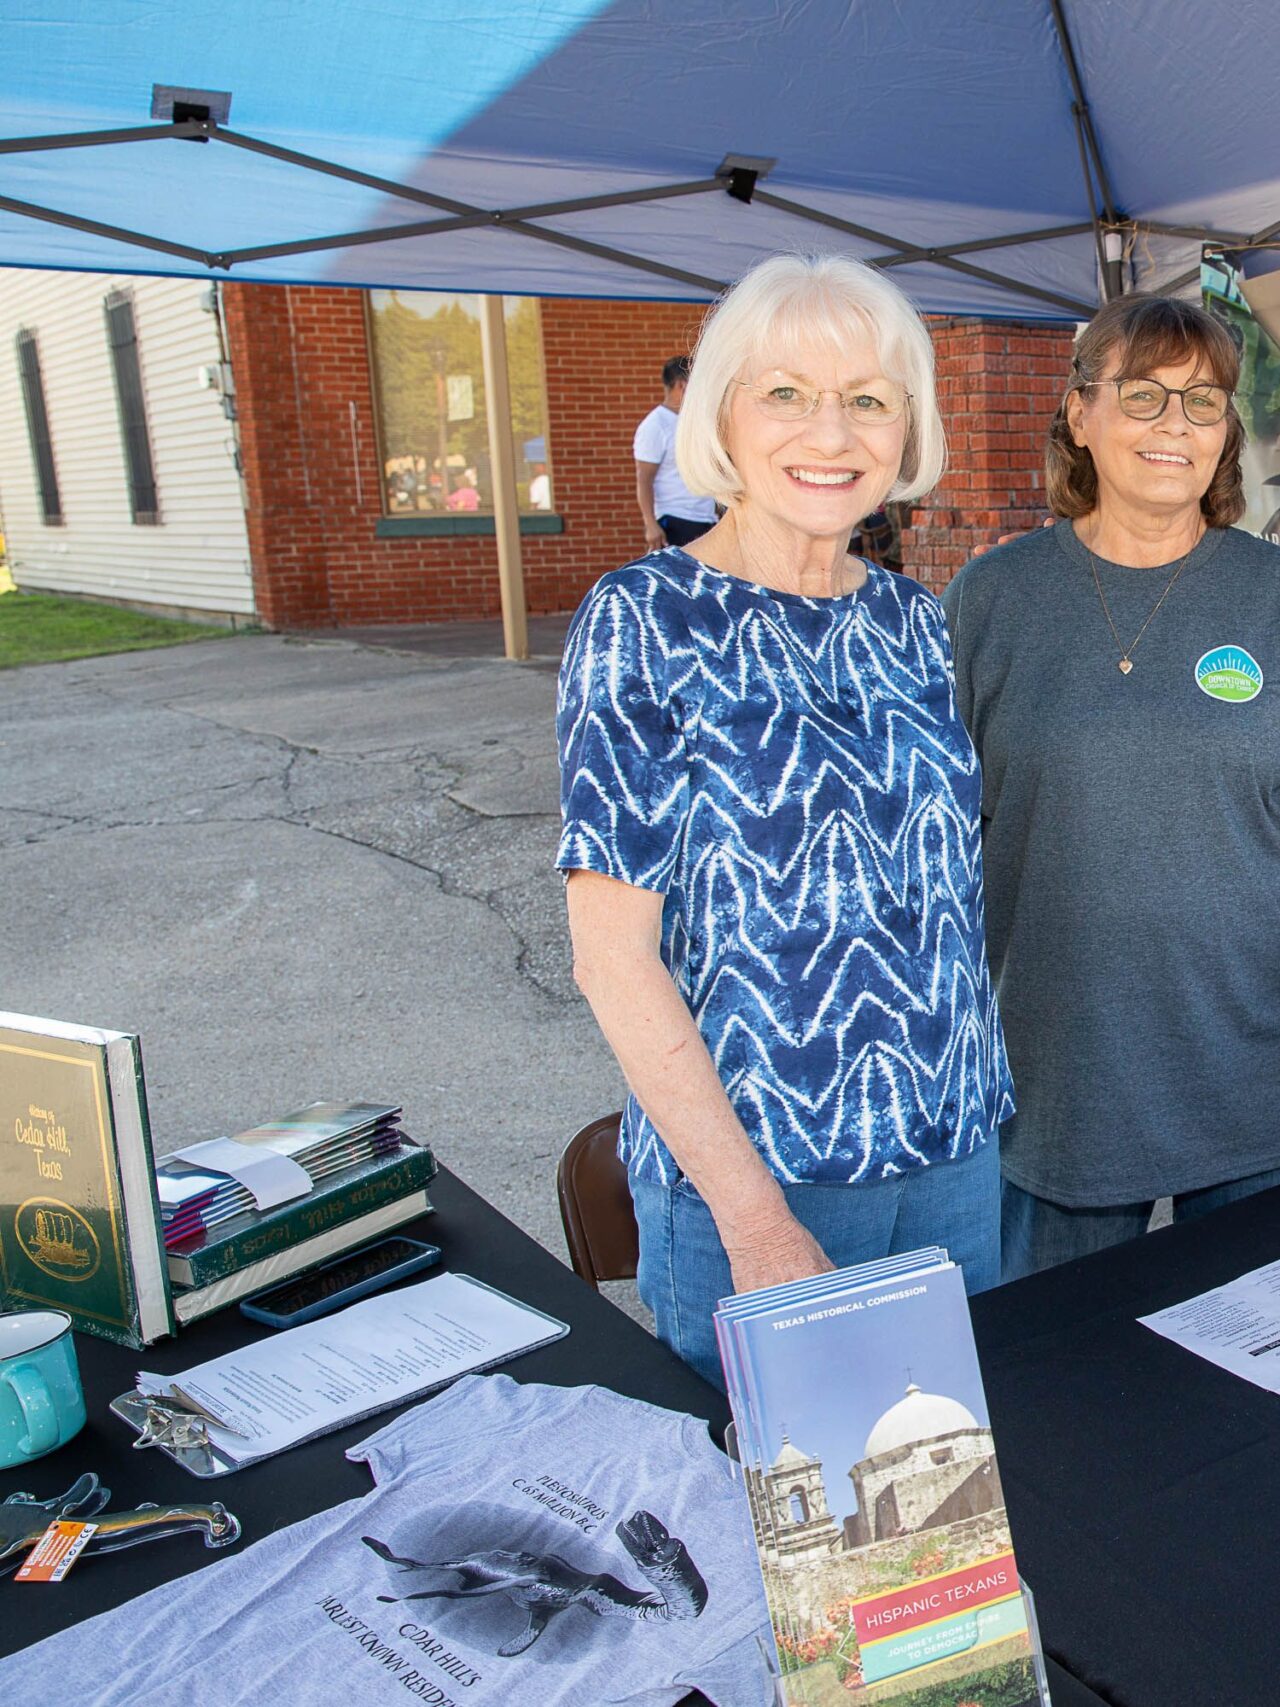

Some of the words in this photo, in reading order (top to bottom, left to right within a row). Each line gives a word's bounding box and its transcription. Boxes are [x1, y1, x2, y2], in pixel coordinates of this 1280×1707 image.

[1208, 675, 1251, 686] DOWNTOWN
[15, 1118, 45, 1147] Cedar
[46, 1126, 71, 1157] Hill,
[33, 1148, 63, 1181] Texas
[772, 1316, 805, 1331] TEXAS
[807, 1302, 865, 1322] HISTORICAL
[866, 1285, 927, 1307] COMMISSION
[521, 1485, 539, 1496] 65
[533, 1492, 582, 1520] MILLION
[536, 1475, 609, 1520] PLESIOSAURUS
[866, 1594, 941, 1629] HISPANIC
[944, 1571, 1007, 1603] TEXANS
[888, 1636, 932, 1657] JOURNEY
[935, 1626, 964, 1641] FROM
[908, 1649, 923, 1660] TO
[924, 1627, 984, 1656] DEMOCRACY
[356, 1630, 409, 1673] KNOWN
[399, 1669, 457, 1707] RESIDE
[434, 1652, 481, 1687] HILL'S
